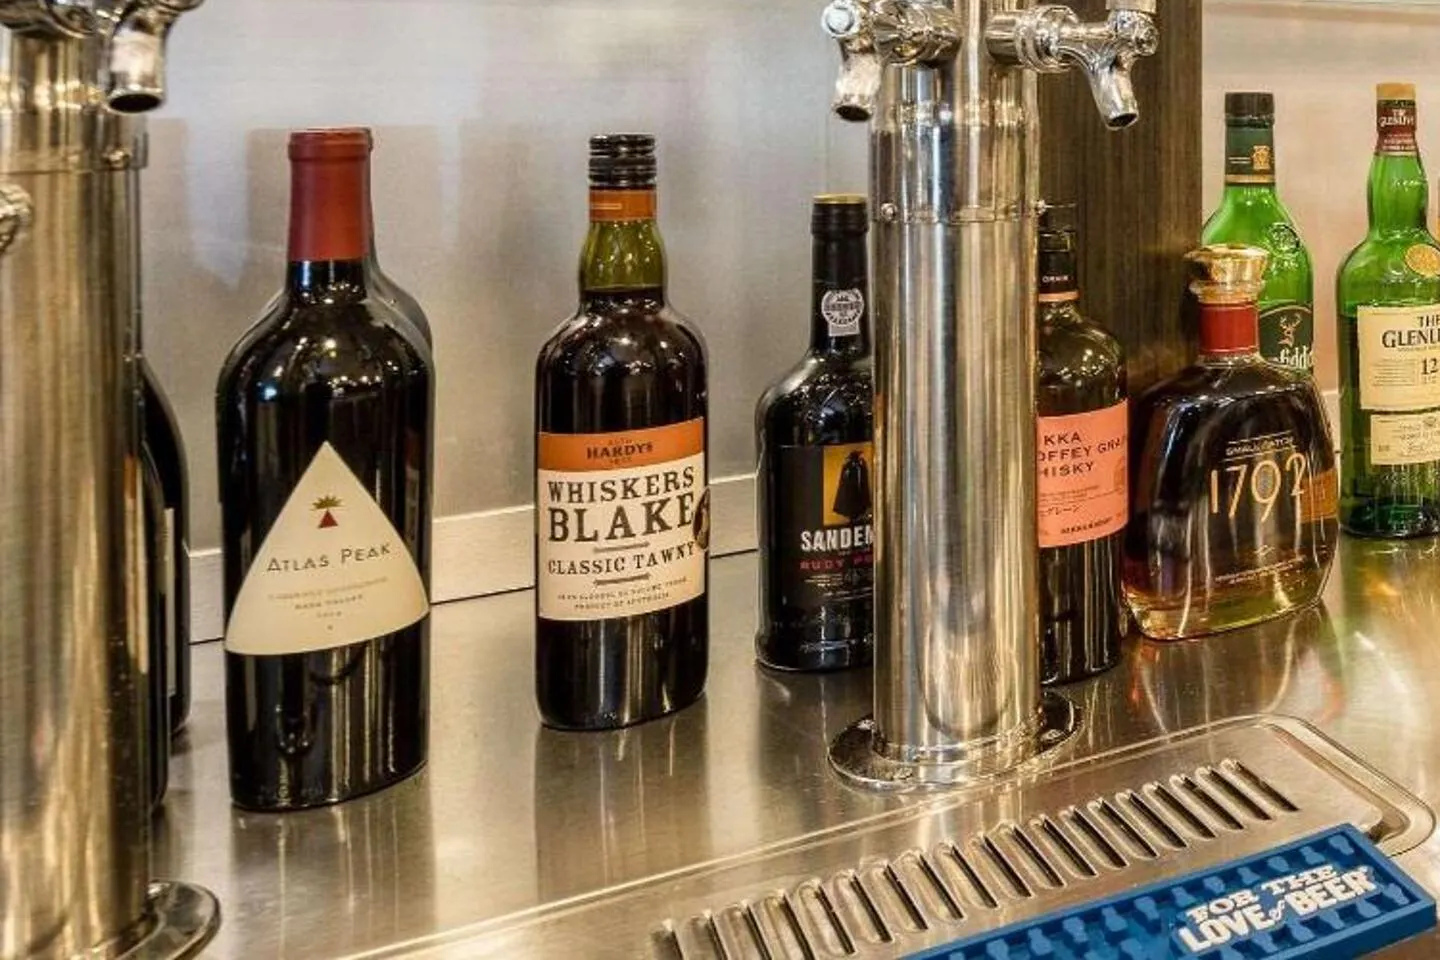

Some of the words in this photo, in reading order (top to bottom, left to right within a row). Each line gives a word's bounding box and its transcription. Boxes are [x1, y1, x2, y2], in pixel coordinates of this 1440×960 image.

[1420, 357, 1440, 375] 12
[1037, 445, 1092, 461] OFFEY
[1043, 431, 1082, 447] KKA
[1039, 461, 1094, 477] HISKY
[548, 466, 695, 504] WHISKERS
[1210, 452, 1307, 523] 1792
[548, 492, 694, 542] BLAKE
[801, 525, 873, 552] SANDE
[267, 555, 330, 572] ATLAS
[340, 543, 391, 564] PEAK
[548, 557, 625, 575] CLASSIC
[633, 541, 694, 569] TAWNY
[1177, 902, 1276, 953] LOVE
[1284, 865, 1378, 916] BEER
[1185, 888, 1260, 924] FOR
[1261, 864, 1338, 896] THE
